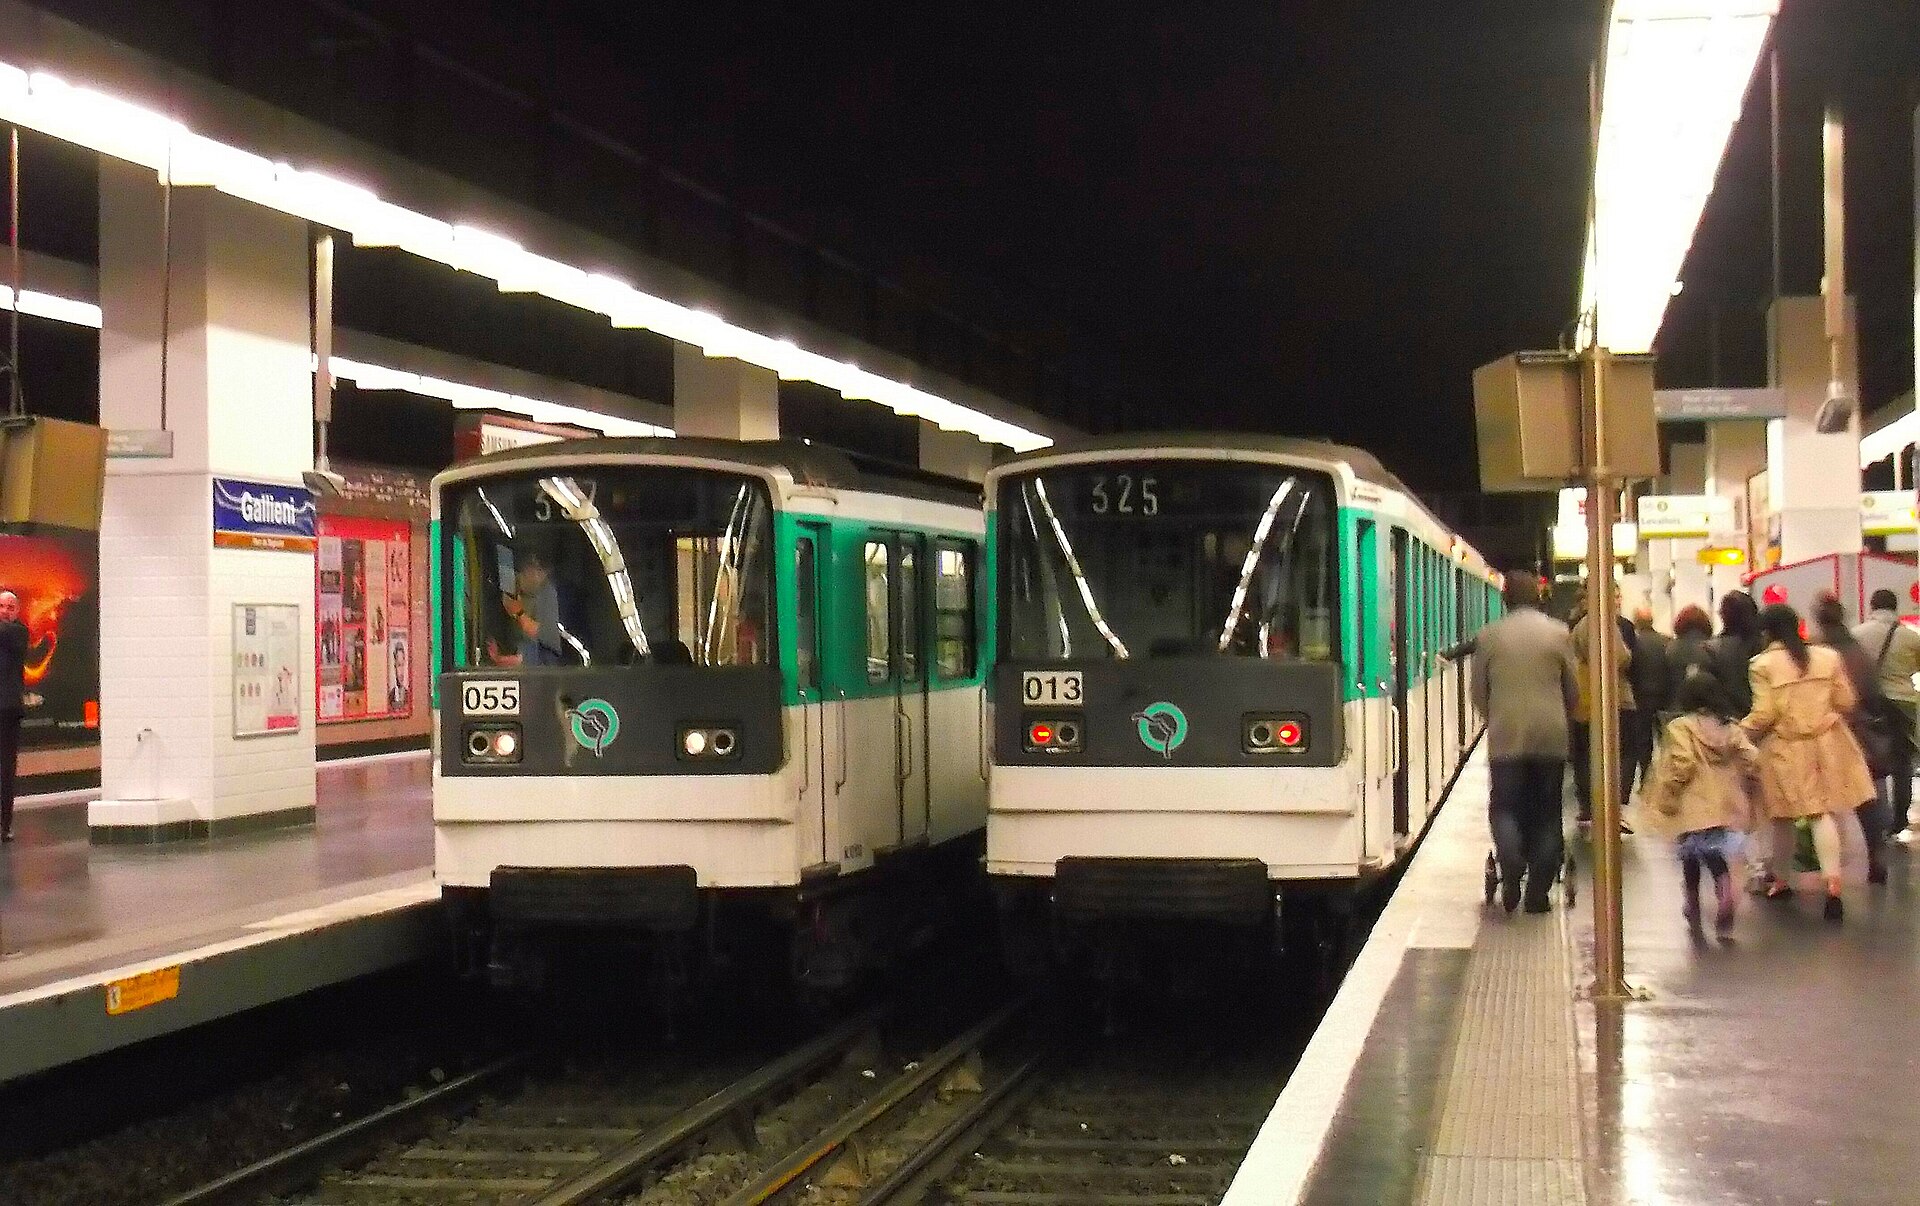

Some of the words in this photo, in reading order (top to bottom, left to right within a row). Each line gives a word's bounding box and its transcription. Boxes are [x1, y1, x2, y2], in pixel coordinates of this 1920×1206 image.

[240, 491, 297, 525] Gallieni
[1092, 475, 1158, 515] 325
[465, 686, 518, 710] 055
[1025, 676, 1081, 701] 013
